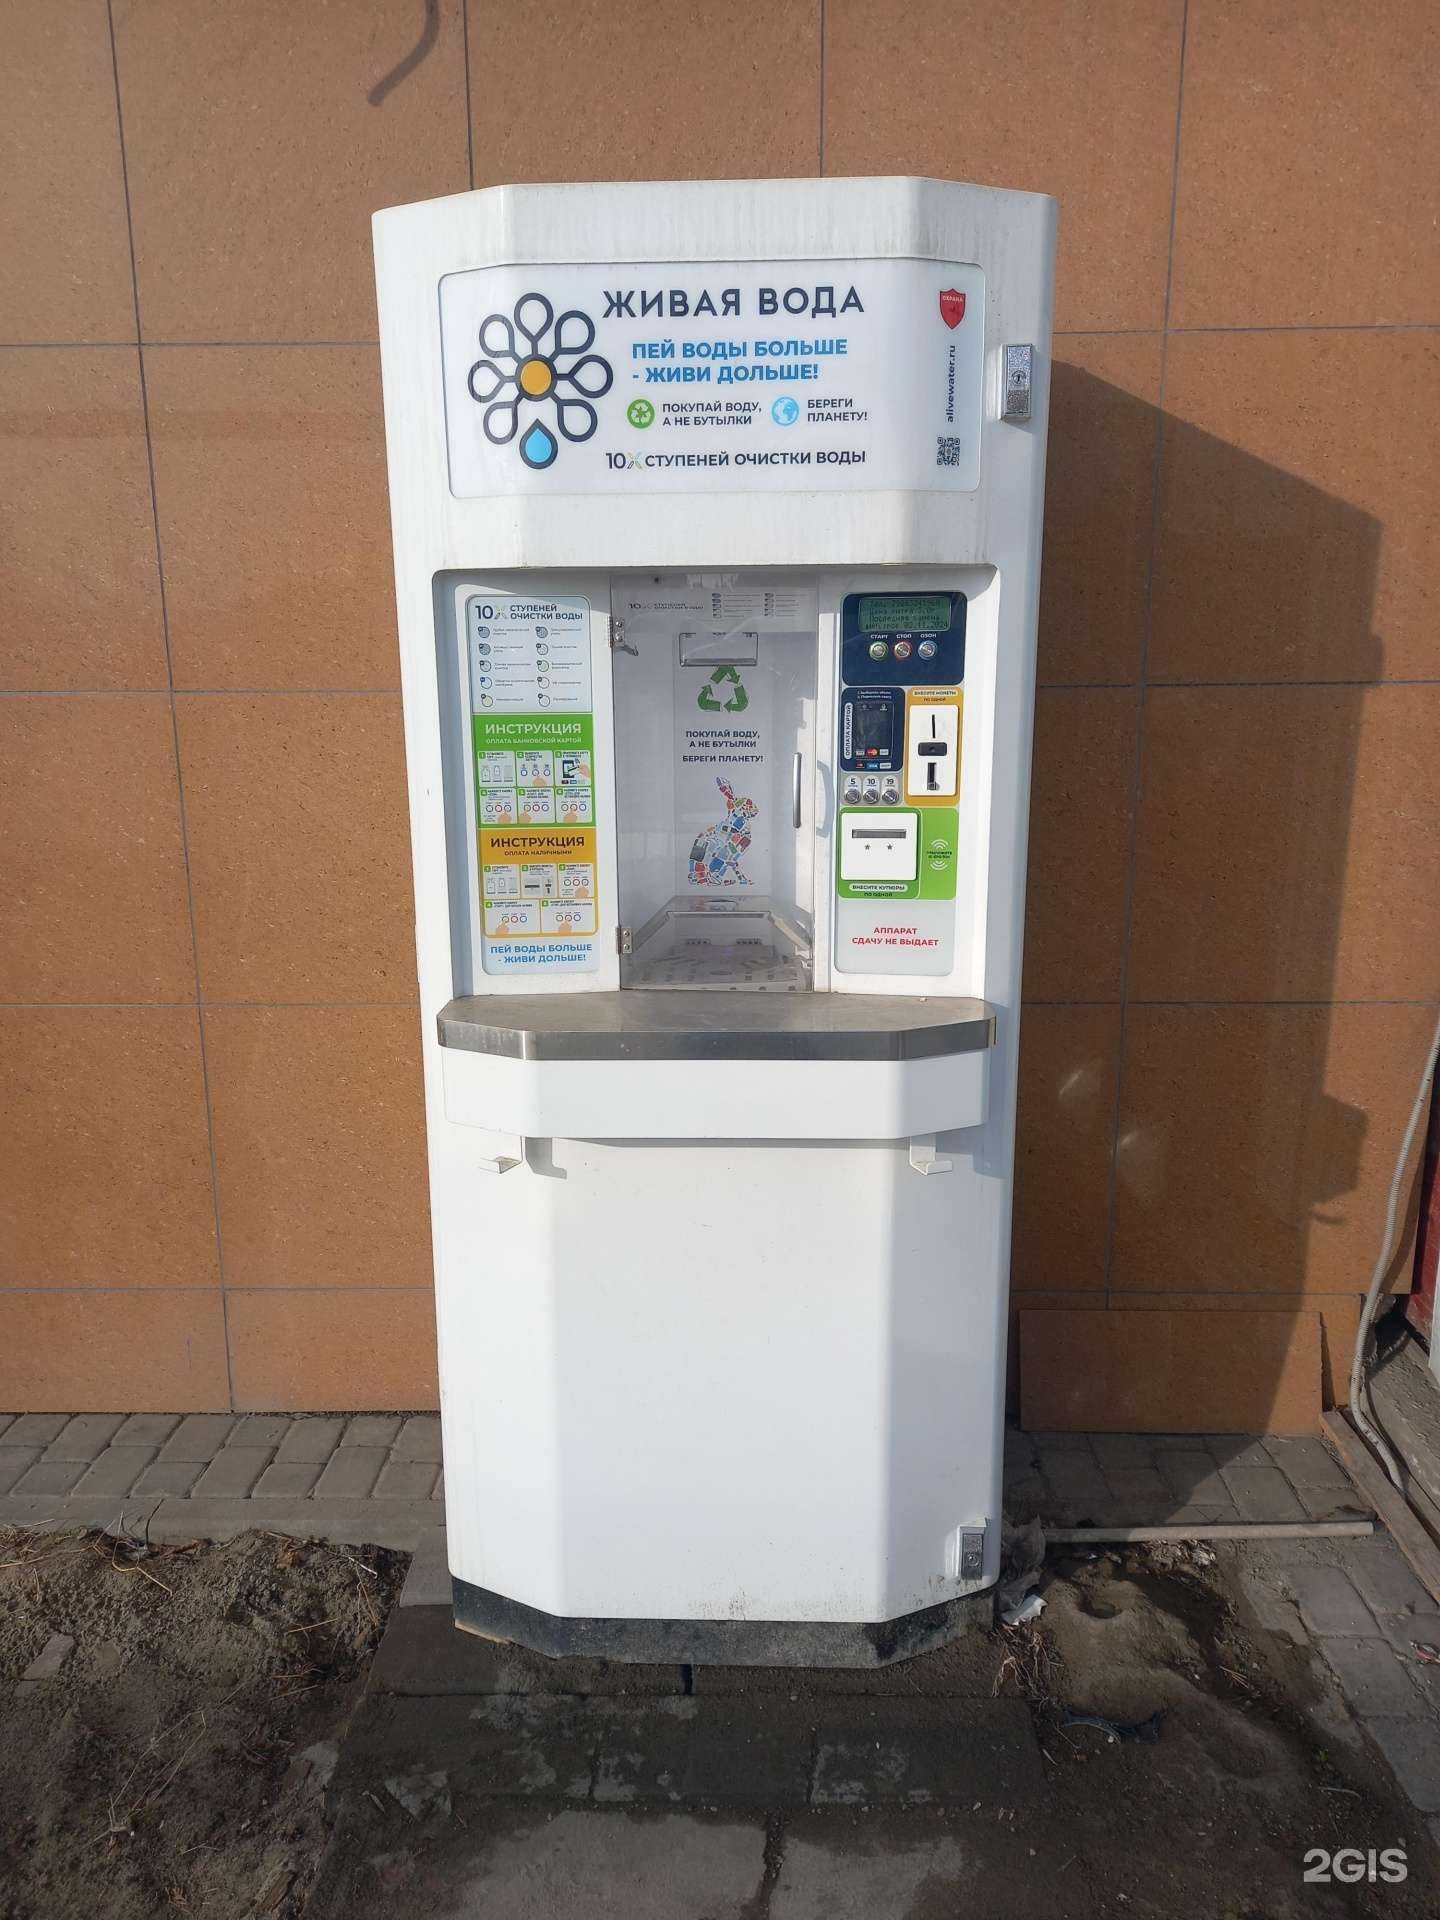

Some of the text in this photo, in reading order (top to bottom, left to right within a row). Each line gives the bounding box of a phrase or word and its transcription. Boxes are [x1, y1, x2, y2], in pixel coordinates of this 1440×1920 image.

[602, 286, 865, 319] ЖИВАЯ ВОДА
[632, 338, 848, 360] ПЕЙ ВОДЫ БОЛЬШЕ
[645, 366, 711, 383] ЖИВИ
[717, 364, 818, 384] ДОЛЬШЕ!
[946, 345, 956, 423] alivewater.ru
[662, 401, 762, 414] ПОКУПАЙ ВОДУ,
[808, 399, 853, 408] БЕРЕГИ
[662, 416, 752, 426] А НЕ БУТЫЛКИ
[808, 412, 868, 422] ПЛАНЕТУ!
[645, 451, 729, 468] СТУПЕНЕЙ
[734, 452, 811, 466] ОЧИСТКИ
[816, 451, 866, 466] ВОДЫ
[510, 604, 557, 612] СТУПЕНЕЙ
[556, 612, 583, 620] ВОДЫ
[485, 723, 582, 735] ИНСТРУКЦИЯ
[686, 730, 760, 739] ПОКУПАЙ ВОДУ,
[491, 836, 584, 848] ИНСТРУКЦИЯ
[900, 938, 939, 946] ВЫДАЕТ
[490, 944, 592, 954] ПЕЙ ВОДЫ БОЛЬШЕ
[504, 955, 535, 963] ЖИВИ
[538, 954, 586, 963] ДОЛЬШЕ!
